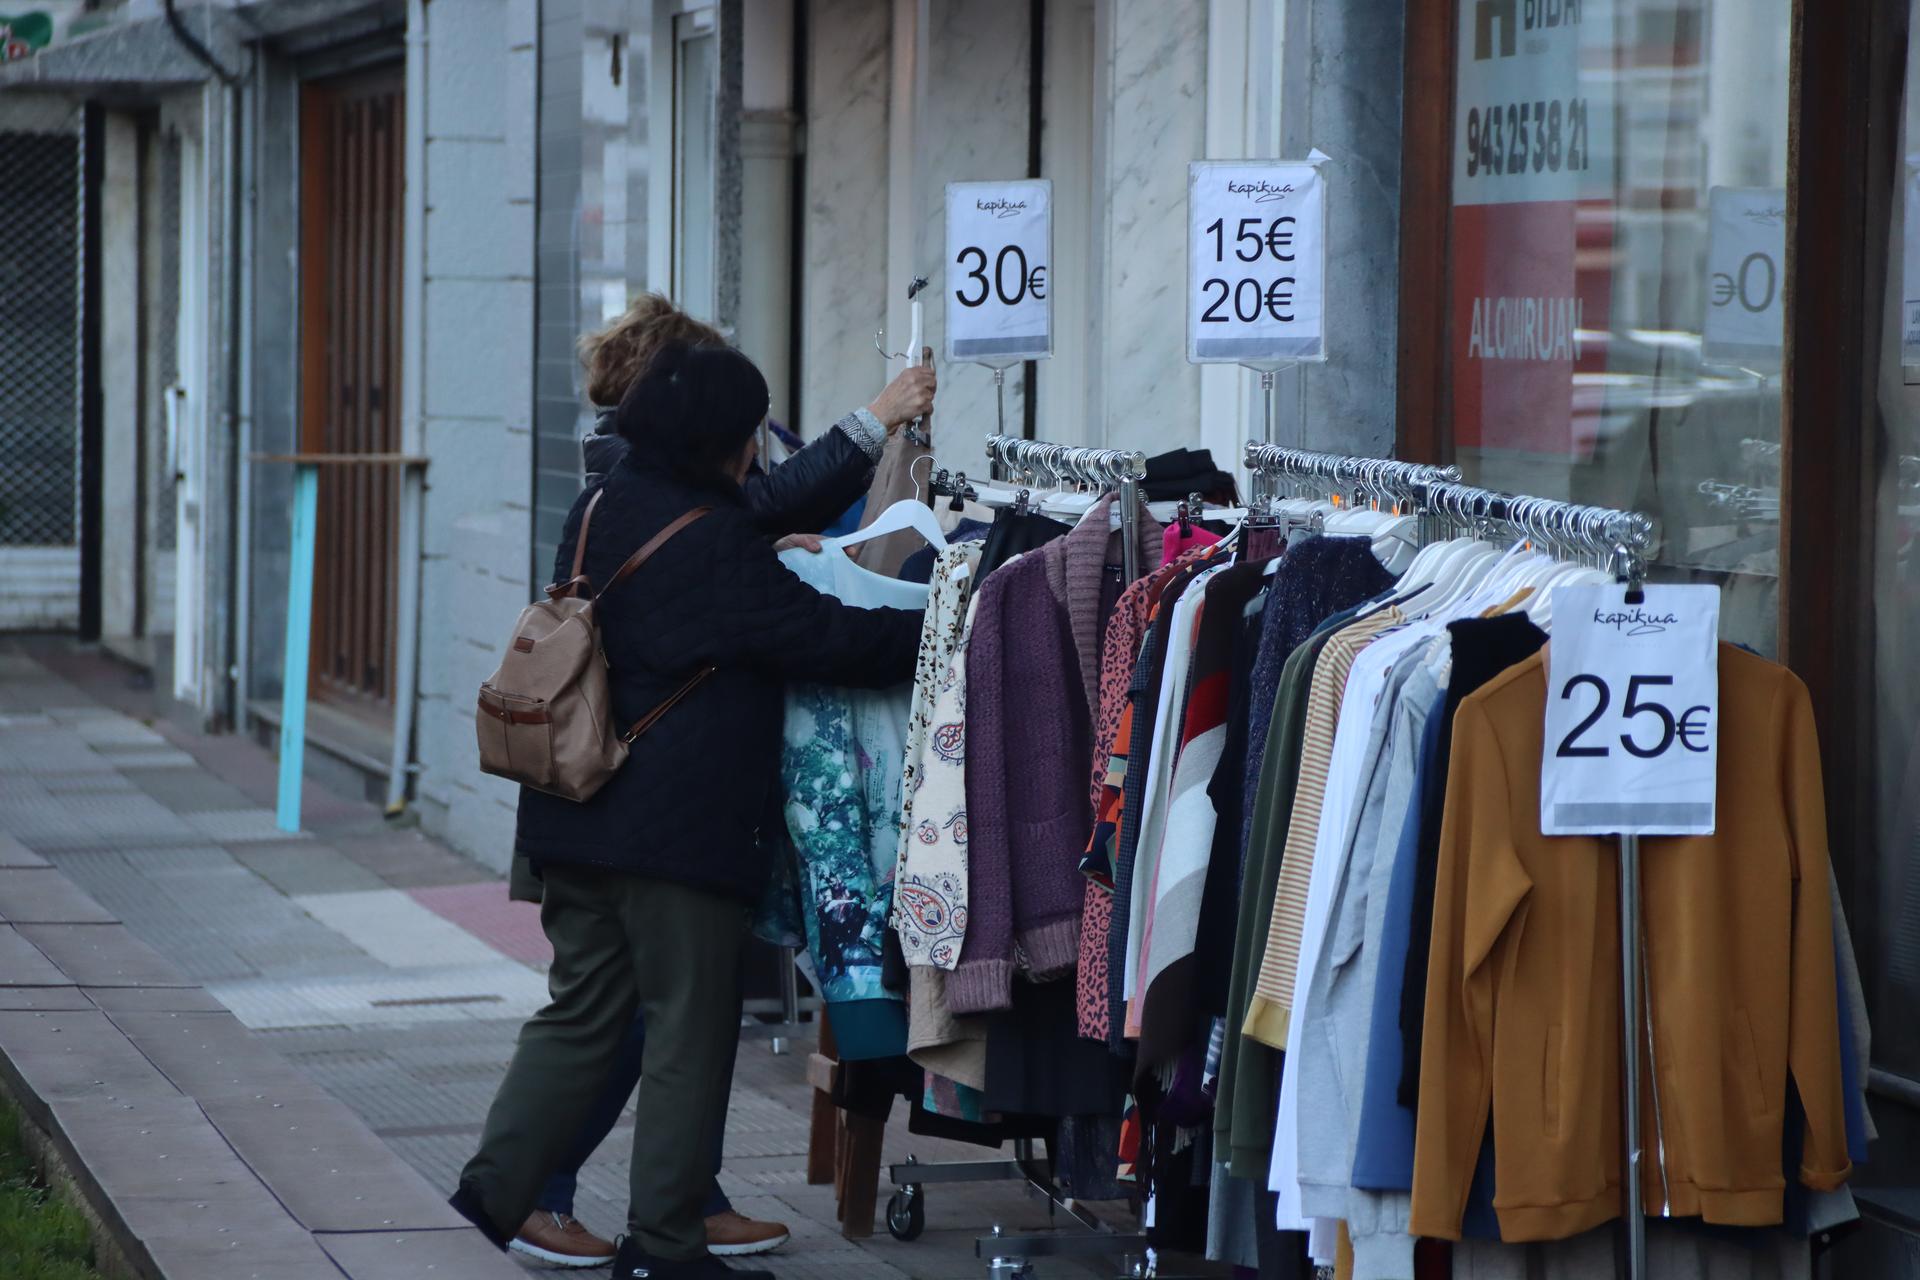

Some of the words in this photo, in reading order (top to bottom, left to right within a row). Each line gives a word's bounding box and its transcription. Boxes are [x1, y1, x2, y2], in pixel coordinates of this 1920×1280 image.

[1467, 106, 1504, 177] 943
[1507, 103, 1529, 174] 25
[1532, 101, 1562, 173] 38
[1567, 98, 1588, 170] 21
[976, 198, 1028, 219] kapikua
[1228, 180, 1295, 203] kapikua
[1206, 216, 1296, 263] 15€
[956, 245, 1047, 308] 30€
[1200, 277, 1296, 323] 20€
[1593, 608, 1679, 637] kapikua
[1555, 673, 1712, 759] 25€
